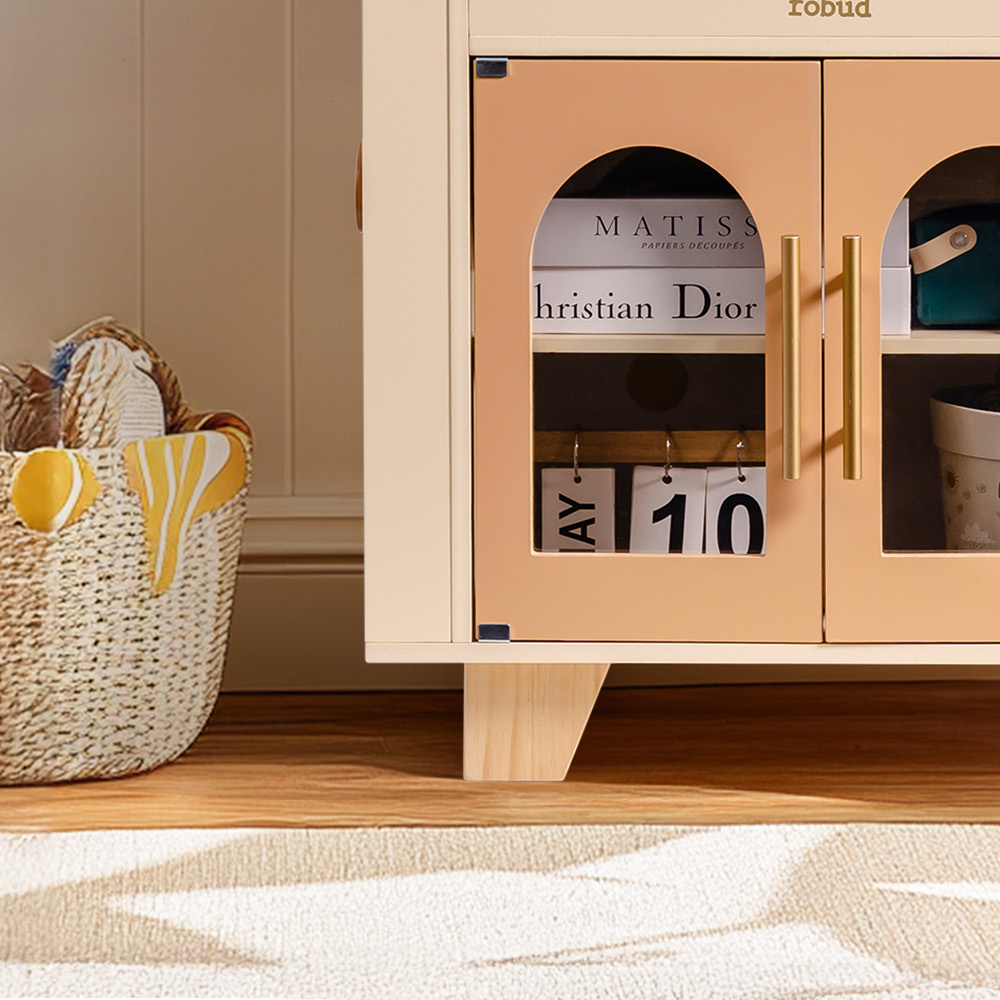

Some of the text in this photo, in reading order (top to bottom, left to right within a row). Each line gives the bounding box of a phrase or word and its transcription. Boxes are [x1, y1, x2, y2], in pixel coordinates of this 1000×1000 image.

[594, 214, 758, 237] MATISS
[641, 241, 686, 250] PAPIERS
[533, 282, 758, 320] hristian Dior
[558, 492, 596, 553] AY
